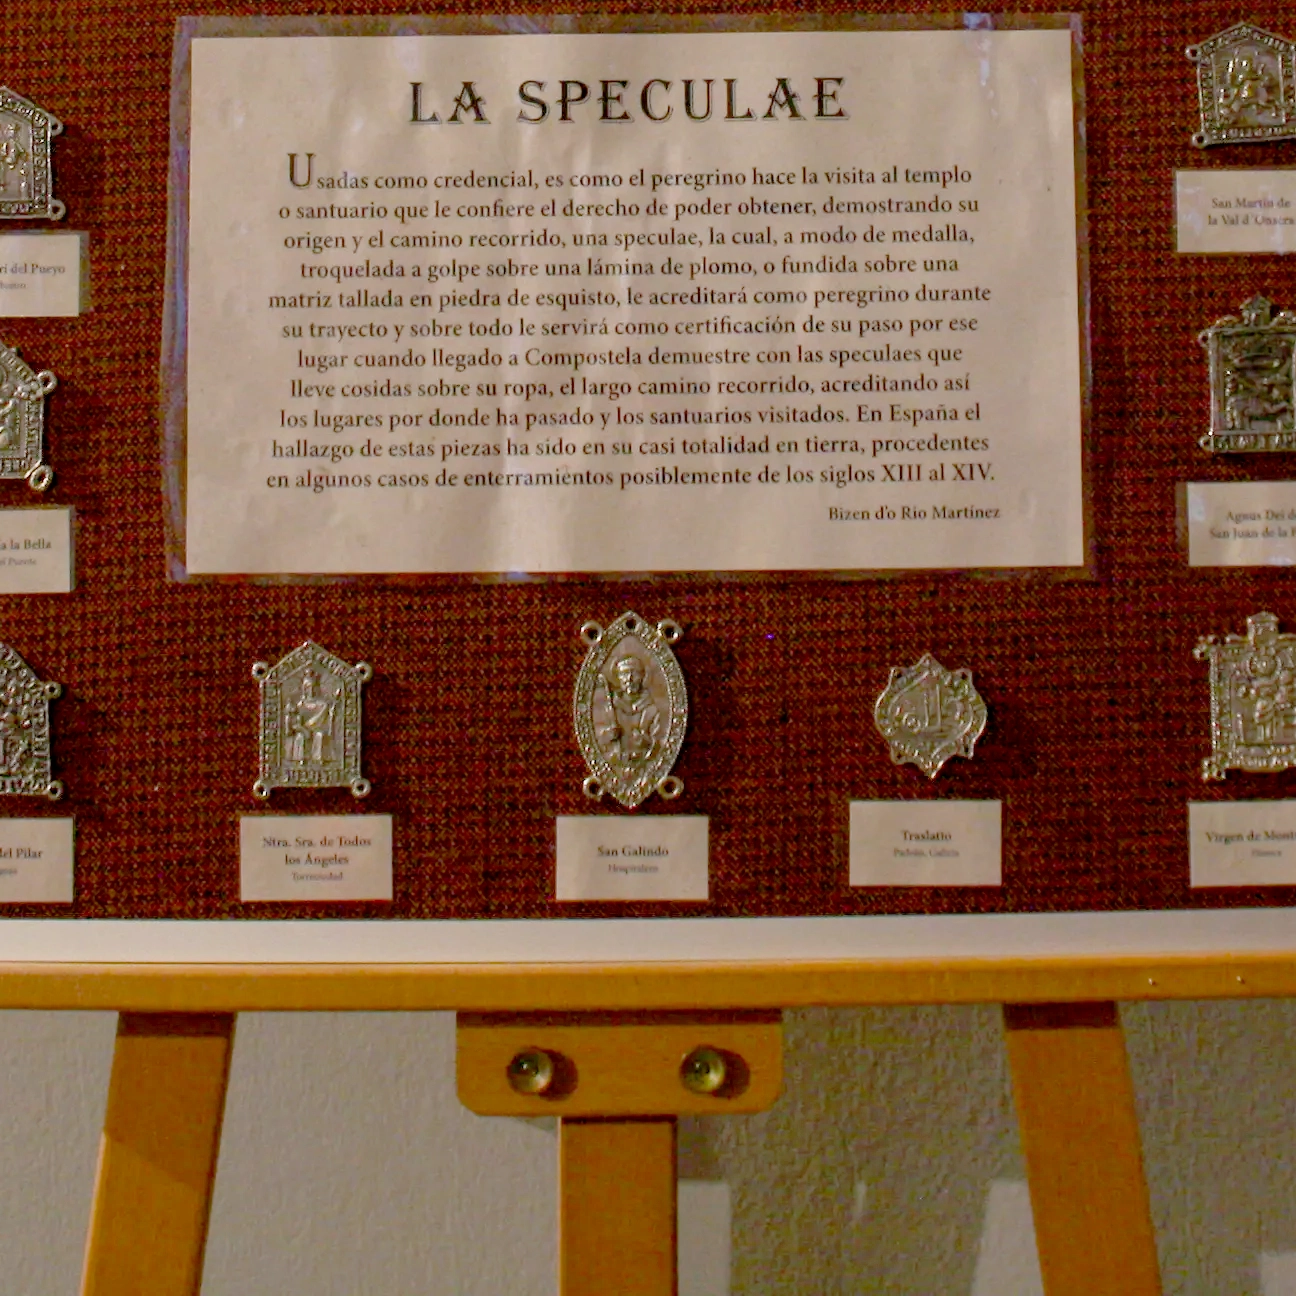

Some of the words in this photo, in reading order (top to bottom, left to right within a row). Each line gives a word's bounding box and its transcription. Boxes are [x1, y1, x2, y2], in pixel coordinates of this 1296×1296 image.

[407, 79, 492, 126] LA
[515, 75, 849, 125] SPECULAE
[372, 174, 428, 189] como
[432, 168, 539, 190] credencial,
[543, 174, 565, 188] es
[568, 173, 623, 187] como
[627, 167, 646, 187] el
[649, 167, 747, 193] peregrino
[750, 165, 797, 186] hace
[801, 165, 819, 185] la
[823, 165, 876, 185] visita
[880, 164, 898, 184] al
[904, 163, 972, 189] templo
[277, 206, 291, 219] o
[295, 200, 388, 220] santuario
[392, 204, 429, 225] que
[433, 198, 451, 218] le
[455, 197, 535, 218] confiere
[539, 197, 556, 217] el
[560, 196, 641, 217] derecho
[644, 196, 669, 217] de
[672, 195, 733, 222] poder
[736, 195, 817, 217] obtener,
[821, 193, 953, 214] demostrando
[957, 199, 979, 213] su
[282, 230, 346, 255] origen
[351, 234, 363, 254] y
[367, 228, 384, 249] el
[389, 229, 463, 248] camino
[468, 227, 567, 249] recorrido,
[570, 232, 609, 248] una
[613, 226, 703, 252] speculae,
[708, 225, 726, 245] la
[730, 225, 778, 246] cual,
[782, 230, 794, 245] a
[799, 223, 858, 244] modo
[861, 223, 886, 243] de
[891, 222, 975, 244] medalla,
[9, 262, 27, 274] del
[31, 262, 65, 275] Pueyo
[299, 258, 406, 284] troquelada
[410, 263, 422, 278] a
[426, 257, 481, 284] golpe
[485, 257, 539, 278] sobre
[543, 262, 582, 277] una
[586, 256, 655, 277] lámina
[659, 255, 684, 276] de
[688, 255, 758, 281] plomo,
[762, 260, 776, 274] o
[780, 253, 858, 274] fundida
[863, 253, 917, 273] sobre
[922, 258, 959, 272] una
[9, 538, 20, 550] la
[23, 538, 51, 549] Bella
[263, 836, 291, 847] Ntra.
[319, 835, 333, 847] de
[337, 835, 371, 846] Todos
[597, 845, 618, 856] San
[621, 845, 668, 856] Galindo
[15, 847, 42, 859] Pilar
